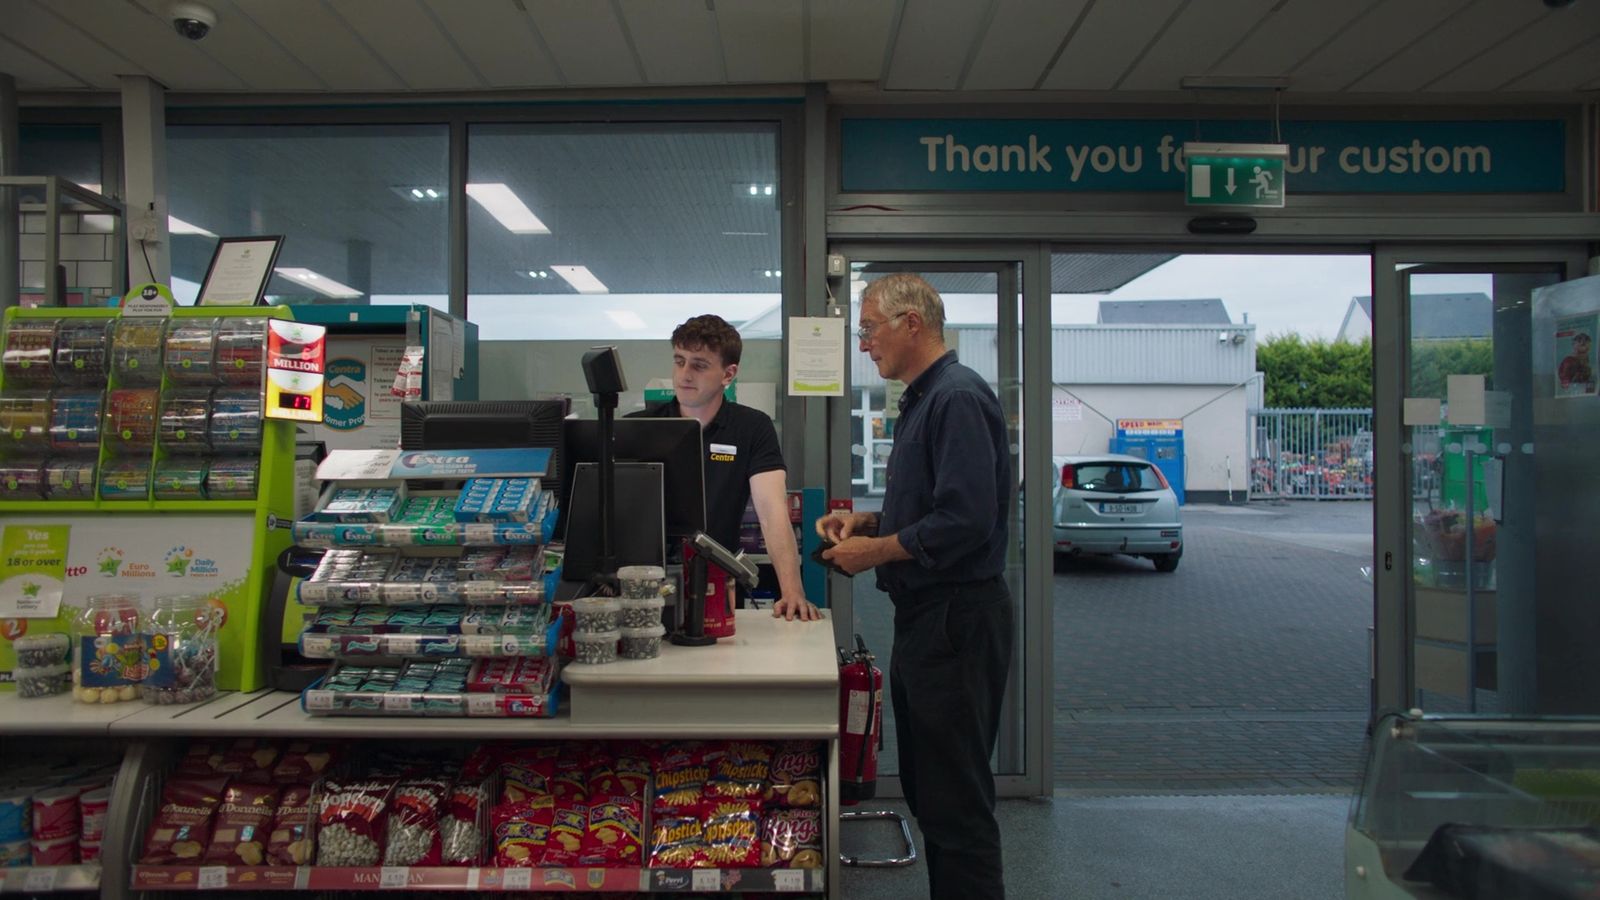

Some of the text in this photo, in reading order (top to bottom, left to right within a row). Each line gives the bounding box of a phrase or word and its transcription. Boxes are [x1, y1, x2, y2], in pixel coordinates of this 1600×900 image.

[919, 134, 1492, 181] Thank you fo ur custom
[274, 358, 320, 371] MILLION
[409, 454, 470, 465] Extra
[710, 453, 735, 462] Centra
[27, 530, 49, 541] Yes
[7, 558, 21, 566] 18
[195, 559, 215, 567] Daily
[511, 701, 539, 712] Extra
[656, 767, 710, 789] Chipsticks
